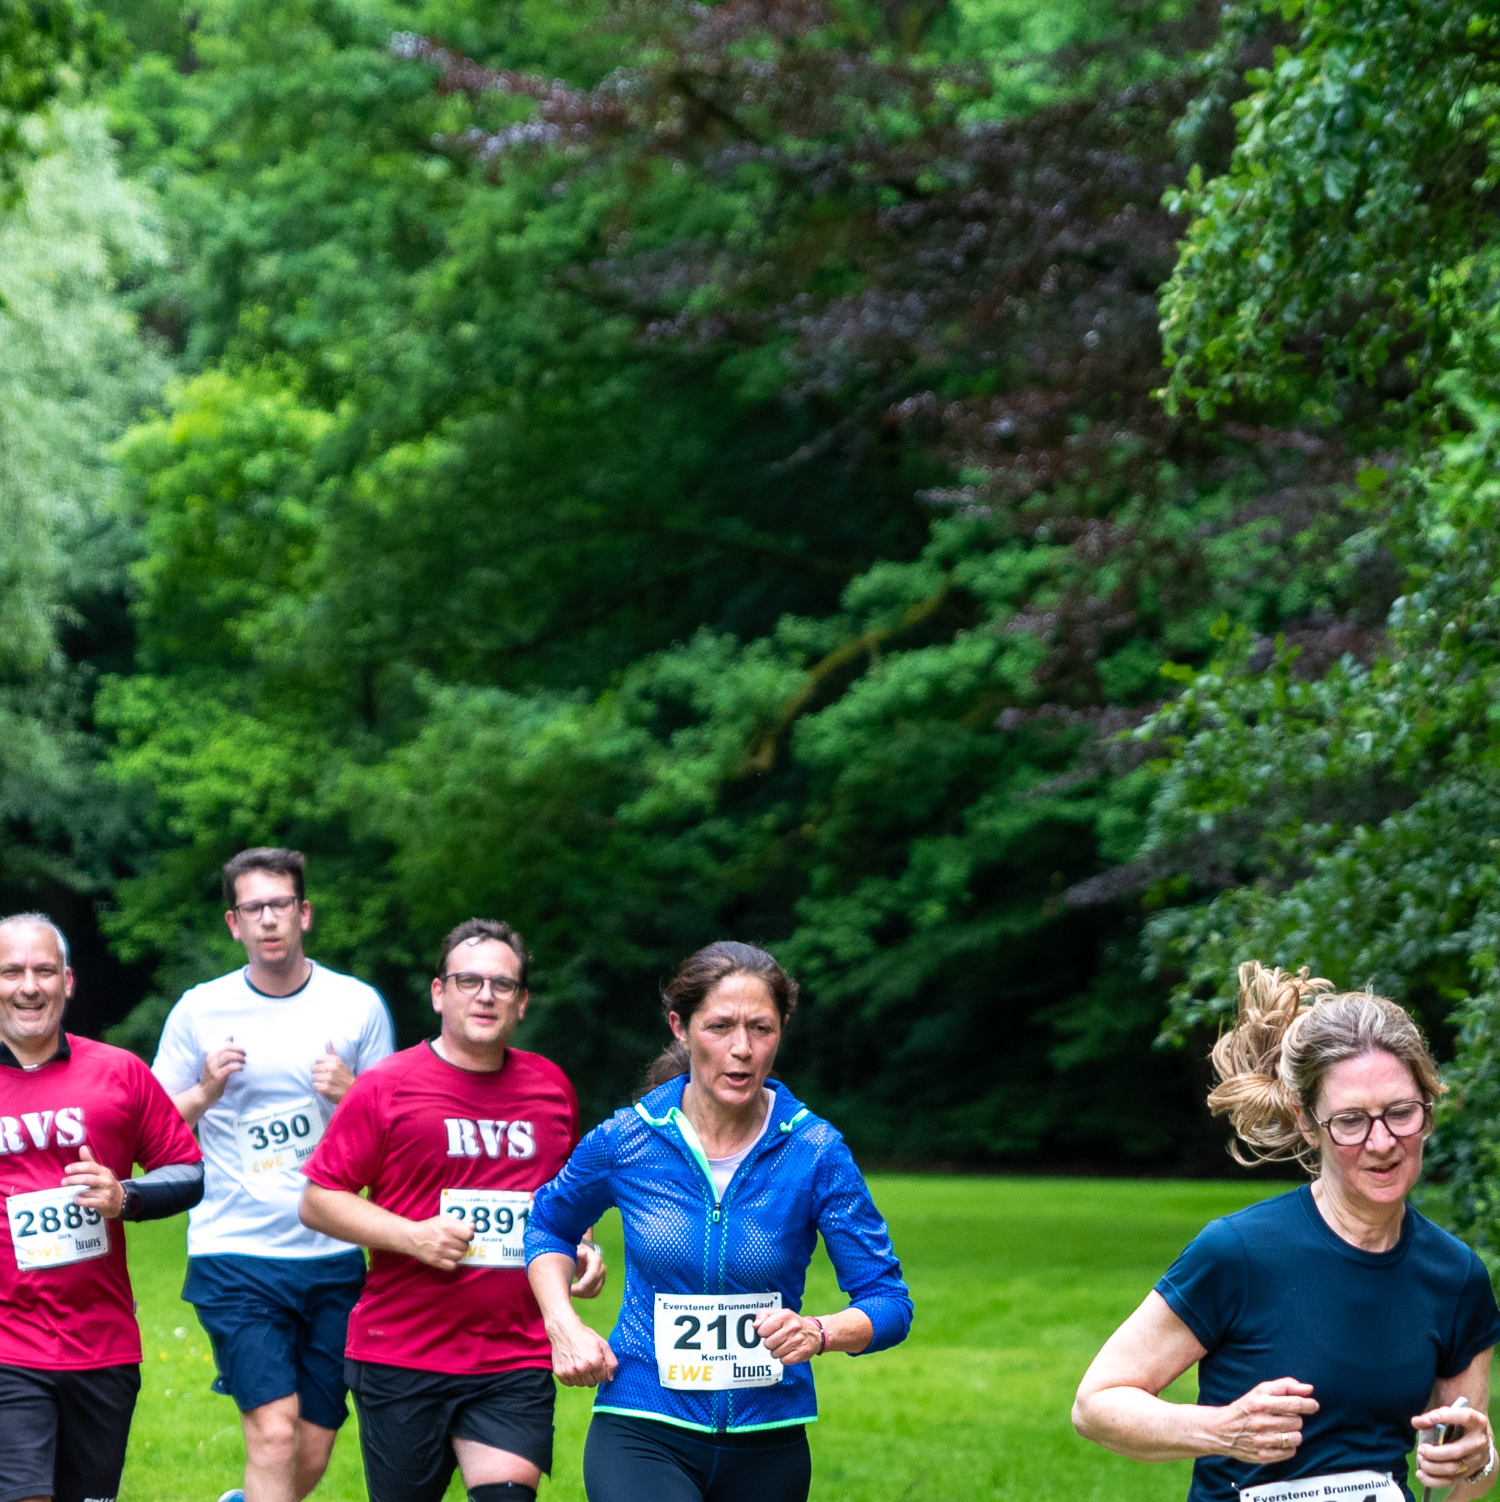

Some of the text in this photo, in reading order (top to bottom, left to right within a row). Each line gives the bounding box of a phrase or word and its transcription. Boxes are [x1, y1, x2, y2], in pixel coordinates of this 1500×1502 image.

[248, 1114, 310, 1150] 390
[444, 1118, 536, 1159] RVS
[252, 1155, 283, 1173] EWE
[14, 1202, 101, 1238] 2889
[75, 1237, 102, 1251] bruns
[503, 1244, 524, 1257] brun
[663, 1300, 774, 1311] Everstener Brunnenlauf
[673, 1313, 762, 1350] 210
[701, 1353, 737, 1361] Kerstin
[667, 1364, 714, 1382] EWE
[733, 1362, 772, 1378] bruns
